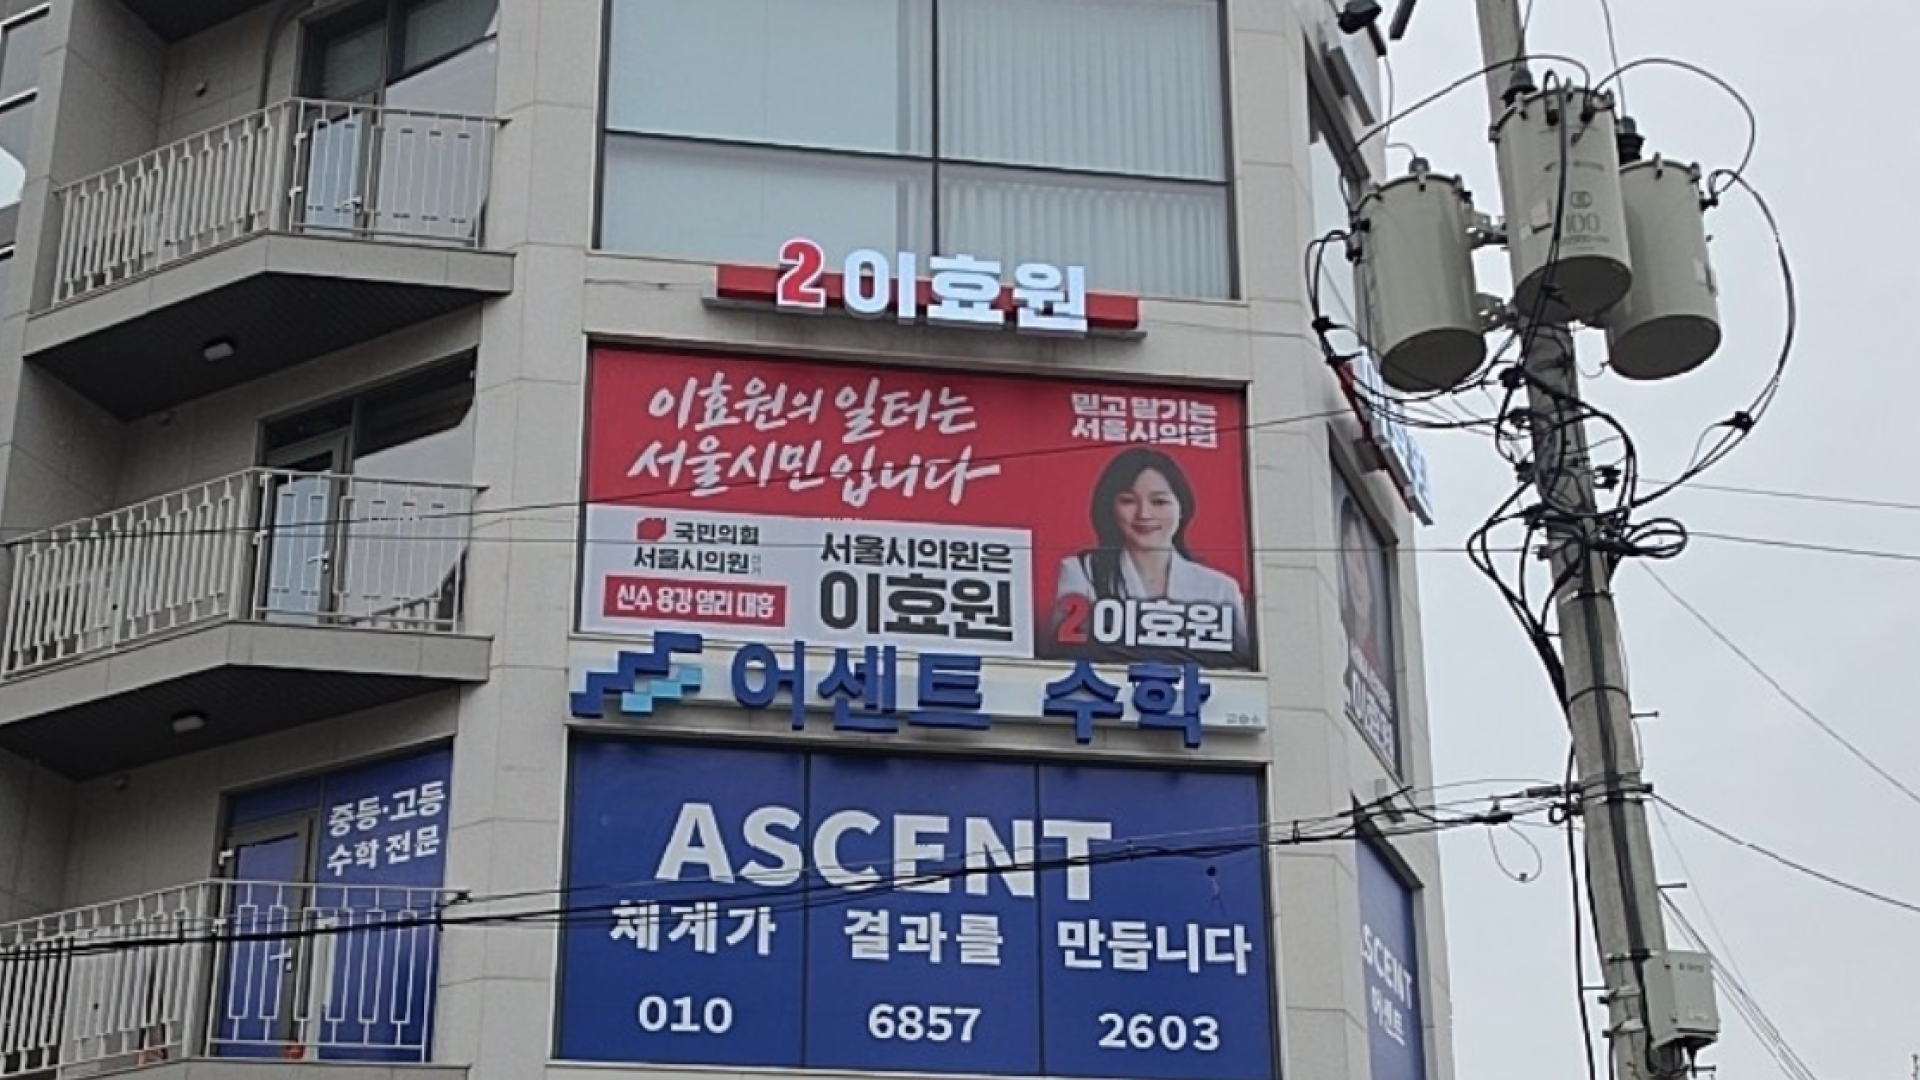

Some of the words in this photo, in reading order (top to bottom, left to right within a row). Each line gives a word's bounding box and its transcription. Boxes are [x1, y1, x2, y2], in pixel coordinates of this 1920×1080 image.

[777, 239, 826, 310] 2
[844, 249, 1088, 334] 이효원
[648, 371, 823, 431] 이효원의
[835, 377, 977, 443] 일터는
[1071, 418, 1218, 449] 서울시의원
[633, 546, 749, 574] 서울시의원
[820, 532, 1013, 574] 서울시의원은
[616, 584, 653, 612] 신수
[656, 586, 692, 614] 용강
[695, 589, 733, 616] 염리
[736, 591, 776, 619] 대흥
[820, 570, 1014, 642] 이효원
[1057, 592, 1089, 643] 2
[1093, 597, 1234, 652] 이효원
[731, 641, 990, 732] 어센트
[1044, 657, 1211, 749] 수학
[327, 838, 380, 877] 수학
[385, 824, 441, 865] 전문
[654, 803, 1112, 900] ASCENT
[609, 899, 777, 956] 체계가
[844, 909, 1004, 967] 결과를
[1057, 918, 1252, 975] 만듭니다
[638, 995, 733, 1034] 010
[867, 1003, 981, 1043] 6857
[1098, 1012, 1221, 1051] 2603
